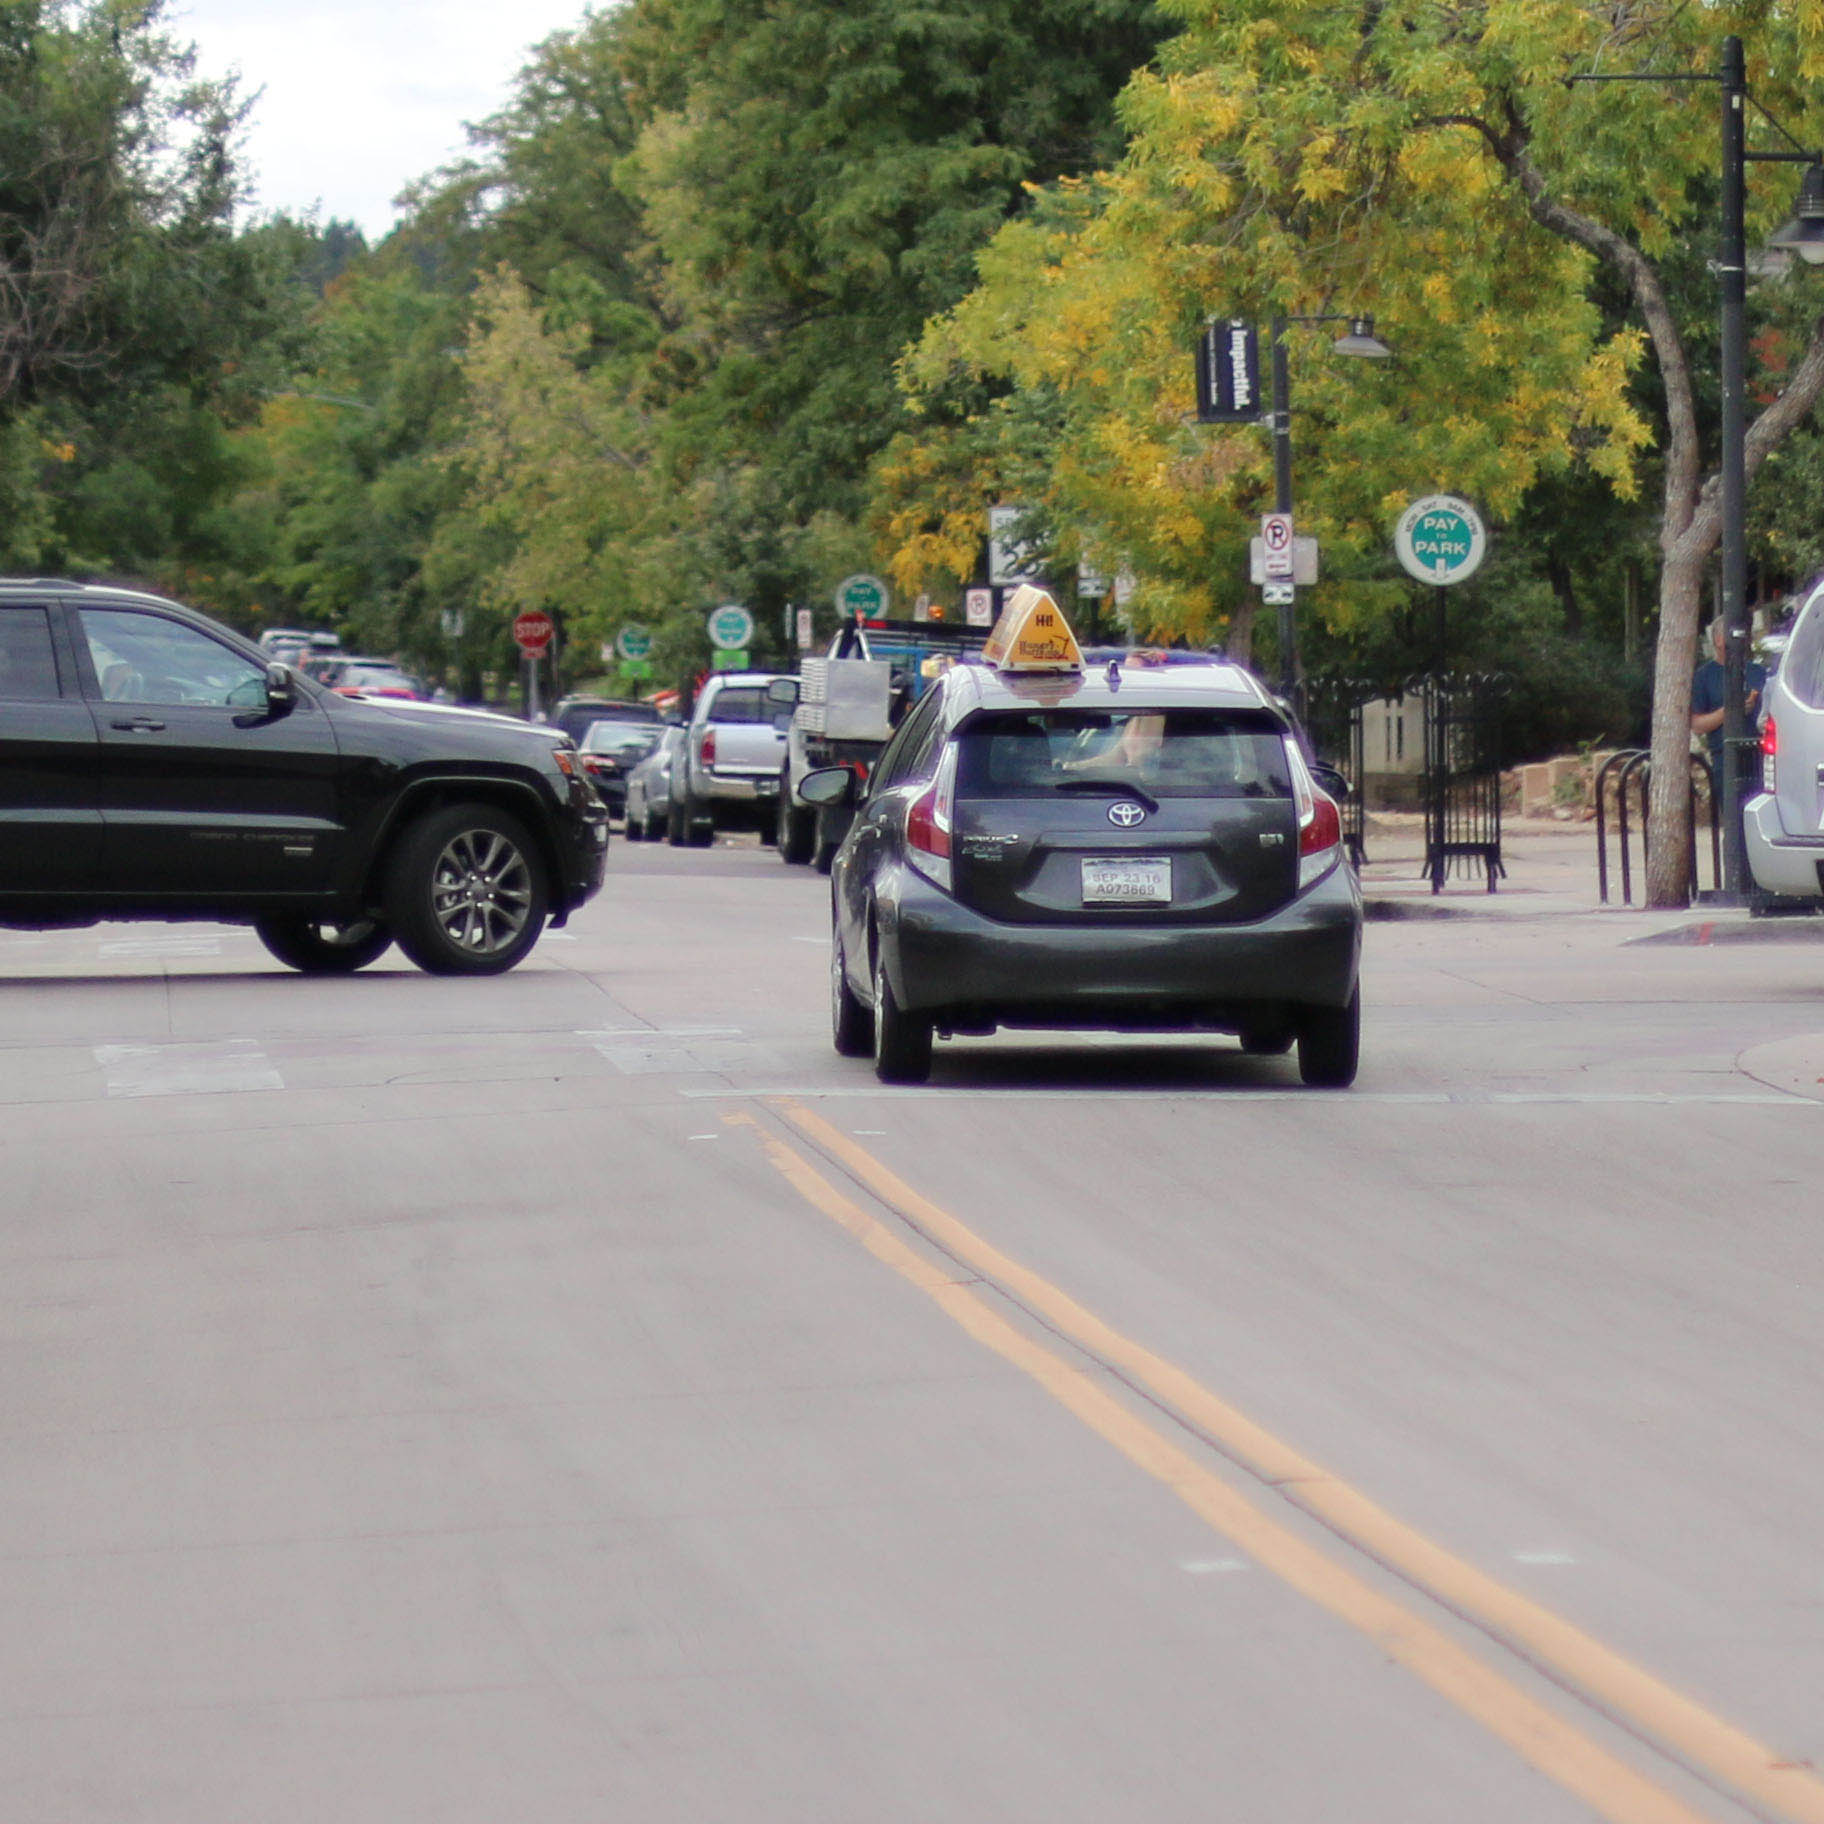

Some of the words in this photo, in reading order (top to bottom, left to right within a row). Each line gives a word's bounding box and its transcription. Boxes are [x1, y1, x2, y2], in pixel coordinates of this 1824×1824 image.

[1229, 328, 1251, 411] Impactful.
[1423, 516, 1460, 531] PAY
[1415, 540, 1467, 555] PARK
[516, 622, 551, 637] STOP
